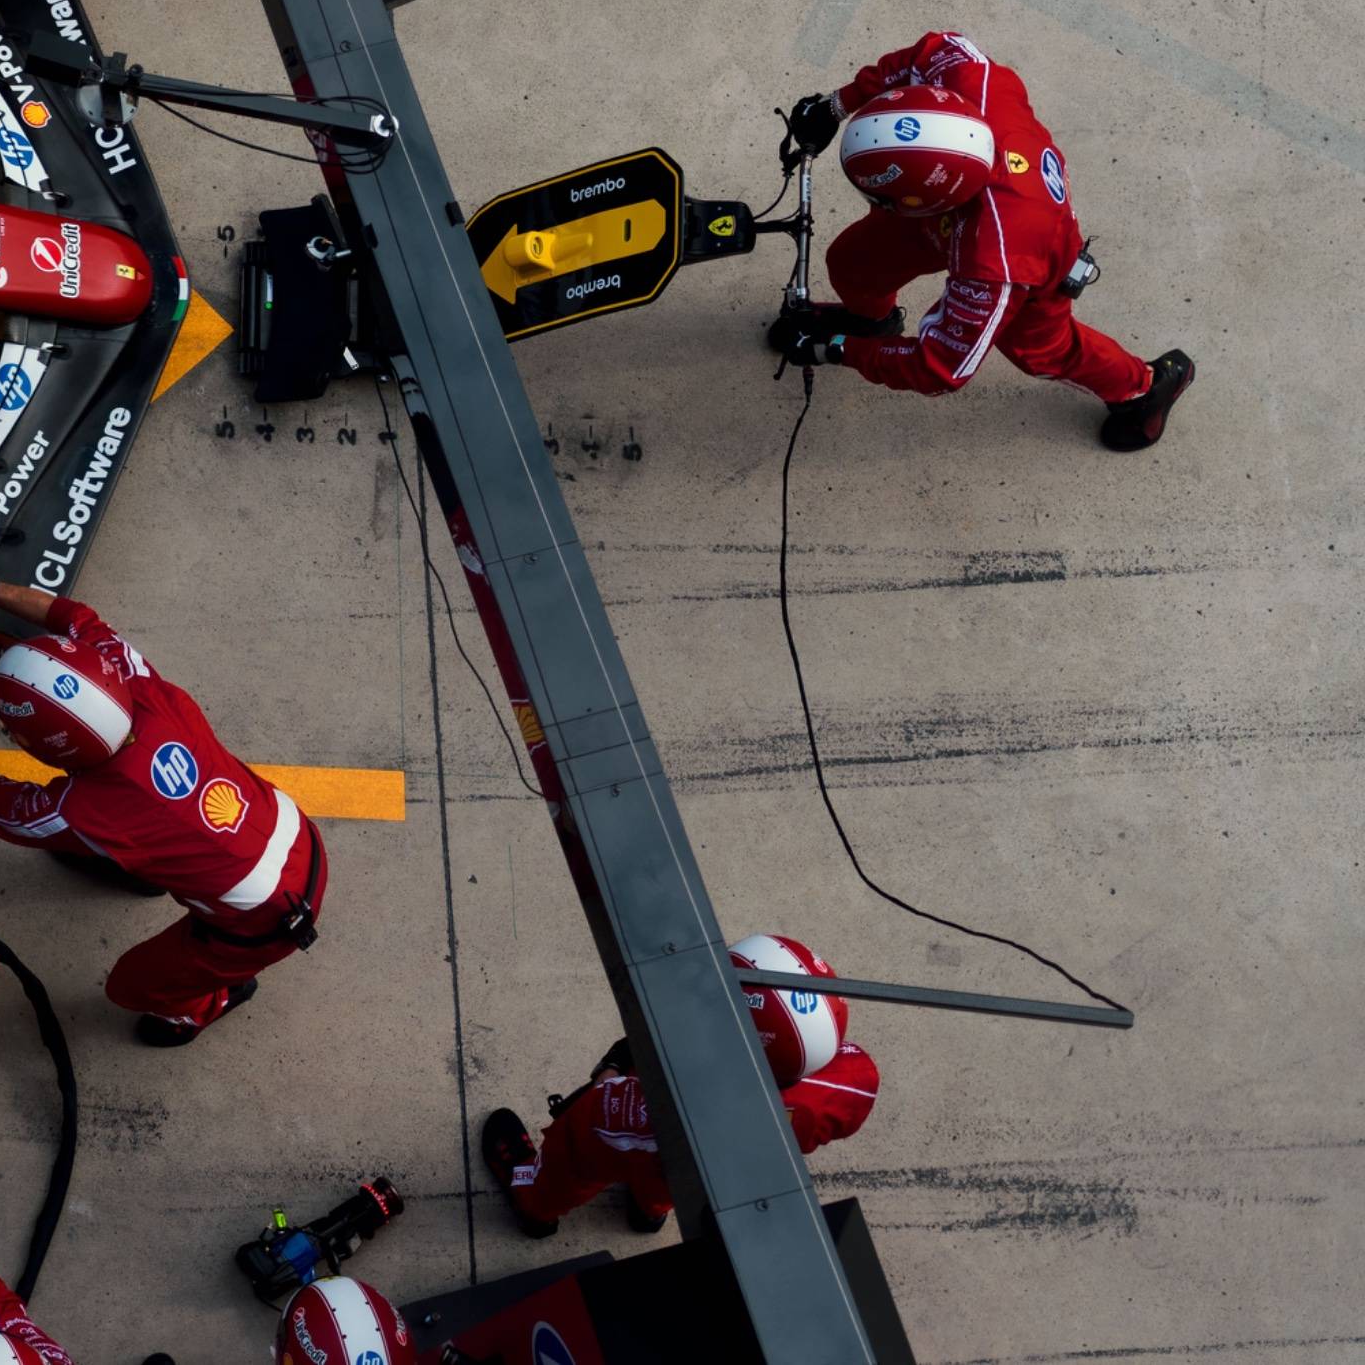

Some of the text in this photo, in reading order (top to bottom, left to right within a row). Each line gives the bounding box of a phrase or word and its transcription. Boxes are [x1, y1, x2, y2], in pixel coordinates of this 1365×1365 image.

[895, 116, 920, 141] hp
[1041, 148, 1065, 204] hp
[570, 177, 626, 203] brembo
[59, 222, 81, 299] UniCredit
[566, 273, 621, 300] brembo
[337, 428, 357, 446] 2
[53, 674, 79, 700] hp
[152, 742, 198, 799] hp
[791, 990, 817, 1014] hp
[295, 1317, 327, 1365] UniCredit
